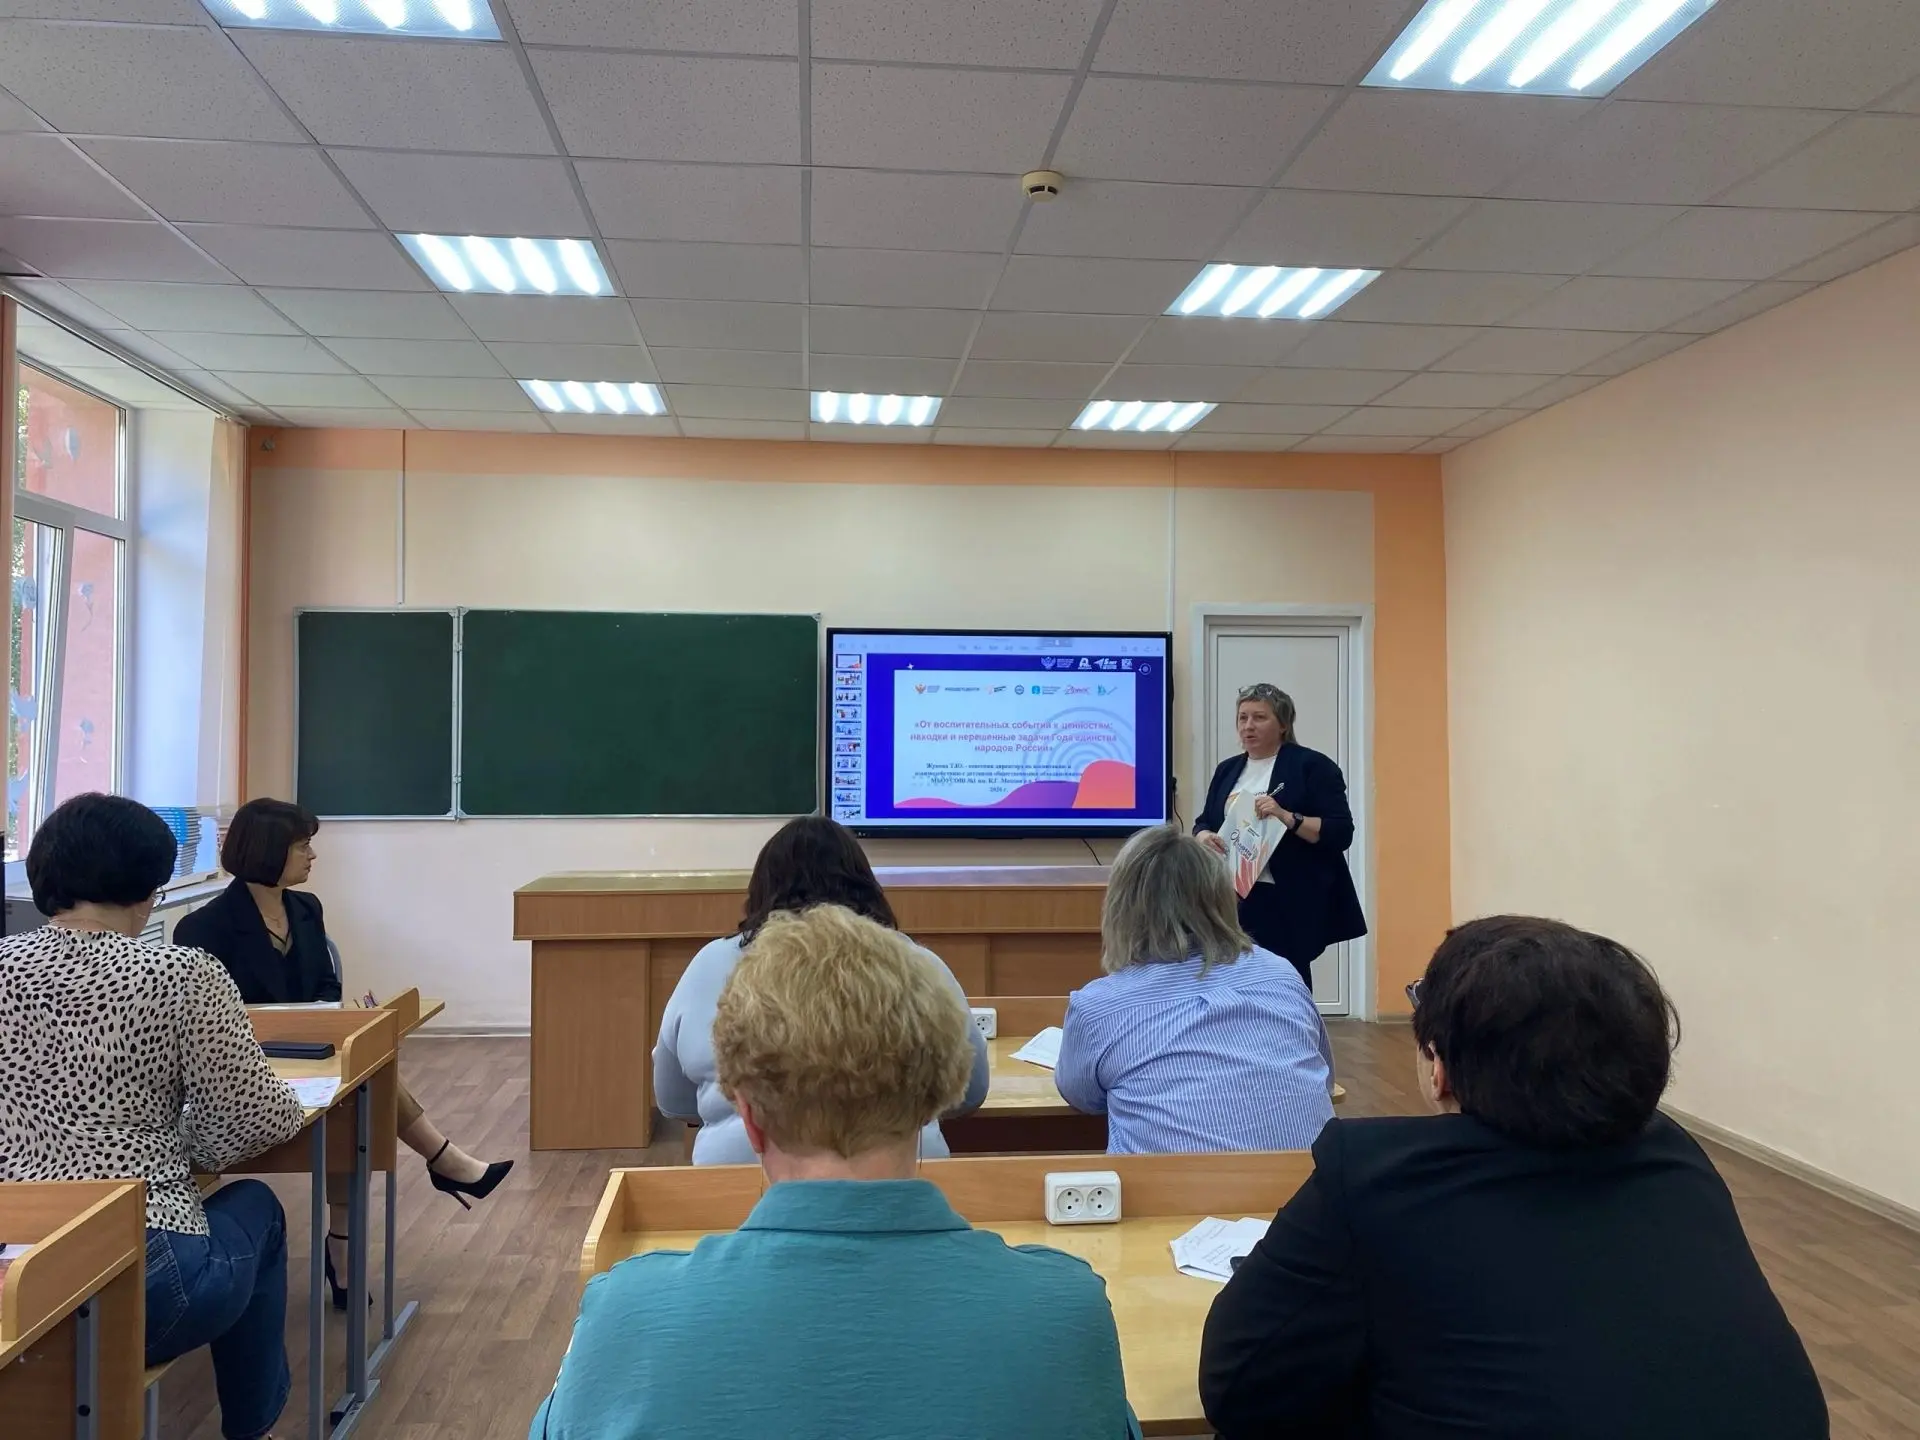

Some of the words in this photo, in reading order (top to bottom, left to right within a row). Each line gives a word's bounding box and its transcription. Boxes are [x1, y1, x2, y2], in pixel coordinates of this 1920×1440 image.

[933, 721, 1009, 729] воспитательных
[1012, 720, 1051, 729] событий
[910, 733, 948, 741] находки
[974, 745, 1013, 753] народов
